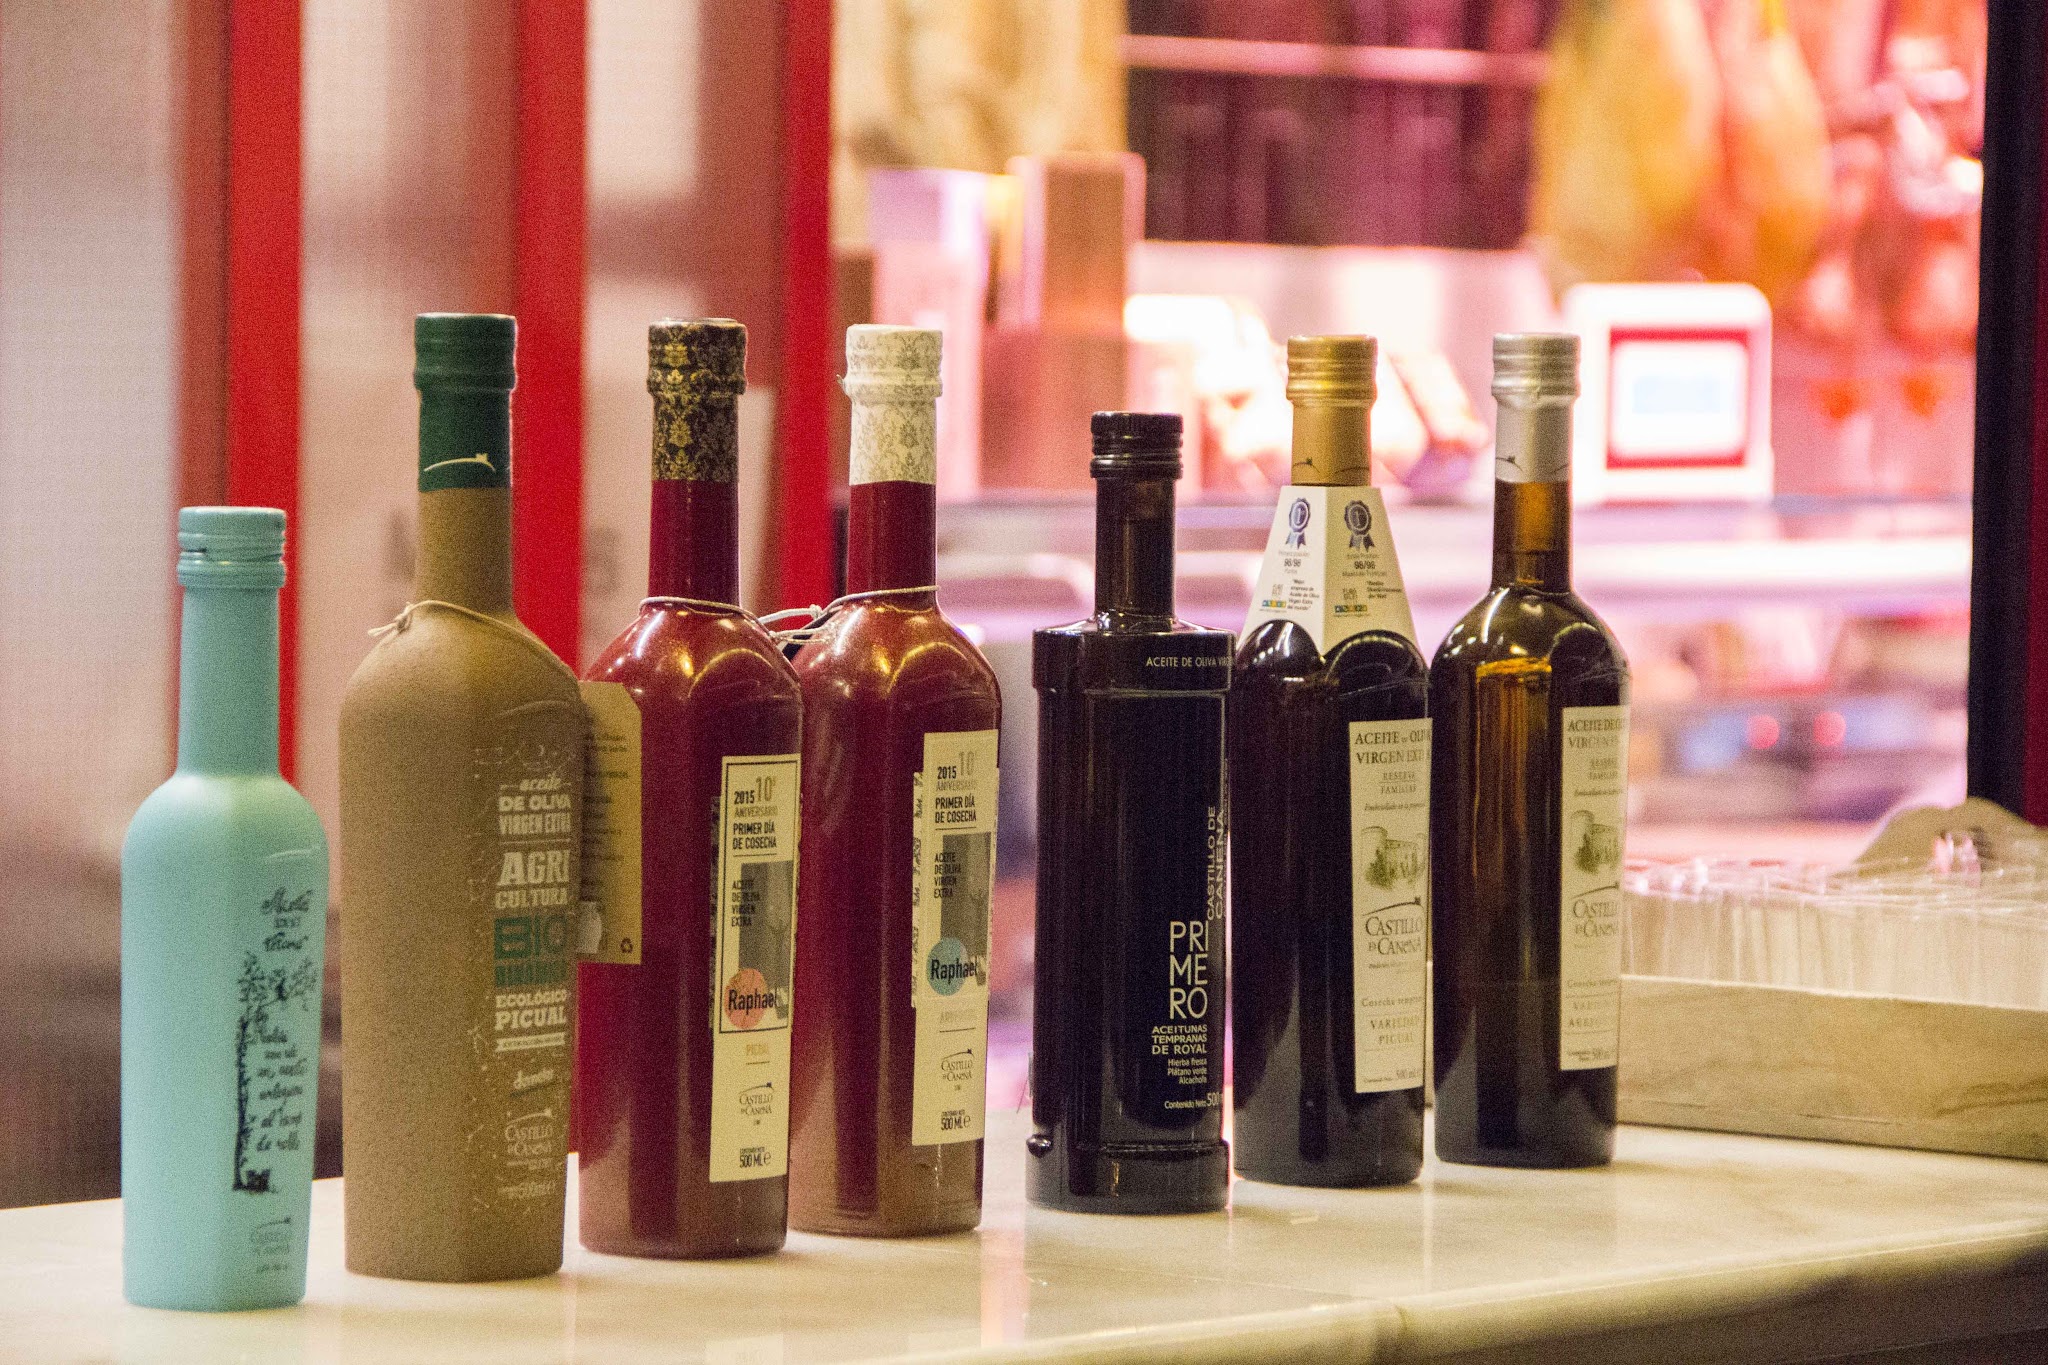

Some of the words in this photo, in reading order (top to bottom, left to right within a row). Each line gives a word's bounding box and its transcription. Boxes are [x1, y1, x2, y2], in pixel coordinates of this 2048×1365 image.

[1146, 657, 1178, 667] ACEITE
[1181, 657, 1192, 667] DE
[1195, 657, 1216, 667] OLIVA
[1355, 731, 1400, 745] ACEITE
[1356, 750, 1403, 764] VIRGEN
[938, 766, 956, 779] 2015
[499, 796, 525, 811] DE
[529, 794, 571, 810] OLIVA
[734, 790, 755, 805] 2015
[935, 797, 963, 809] PRIMER
[965, 793, 975, 807] DÍA
[735, 805, 778, 817] ANIVERSARIO
[935, 812, 944, 823] DE
[947, 810, 976, 823] COSECHA
[1208, 806, 1216, 831] DE
[500, 813, 543, 835] VIRGEN
[733, 822, 762, 835] PRIMER
[764, 820, 775, 834] DÍA
[732, 837, 742, 850] DE
[745, 836, 777, 849] COSECHA
[498, 850, 570, 886] AGRI
[934, 864, 942, 875] DE
[1215, 809, 1224, 920] CANENA
[1207, 835, 1216, 922] CASTILLO
[495, 887, 568, 909] CULTURA
[1365, 915, 1423, 937] CASTILLO
[495, 915, 568, 960] BIO
[930, 957, 978, 985] Raphael
[496, 989, 567, 1008] ECOLÓGICO
[728, 988, 778, 1015] Raphael
[495, 1006, 566, 1031] PICUAL
[1152, 1024, 1208, 1035] ACEITUNAS
[1152, 1034, 1208, 1045] TEMPRANAS
[1152, 1045, 1169, 1055] DE
[1174, 1043, 1208, 1055] ROYAL
[1168, 1058, 1190, 1067] Hierba
[941, 1117, 953, 1131] 500
[740, 1155, 753, 1169] 500
